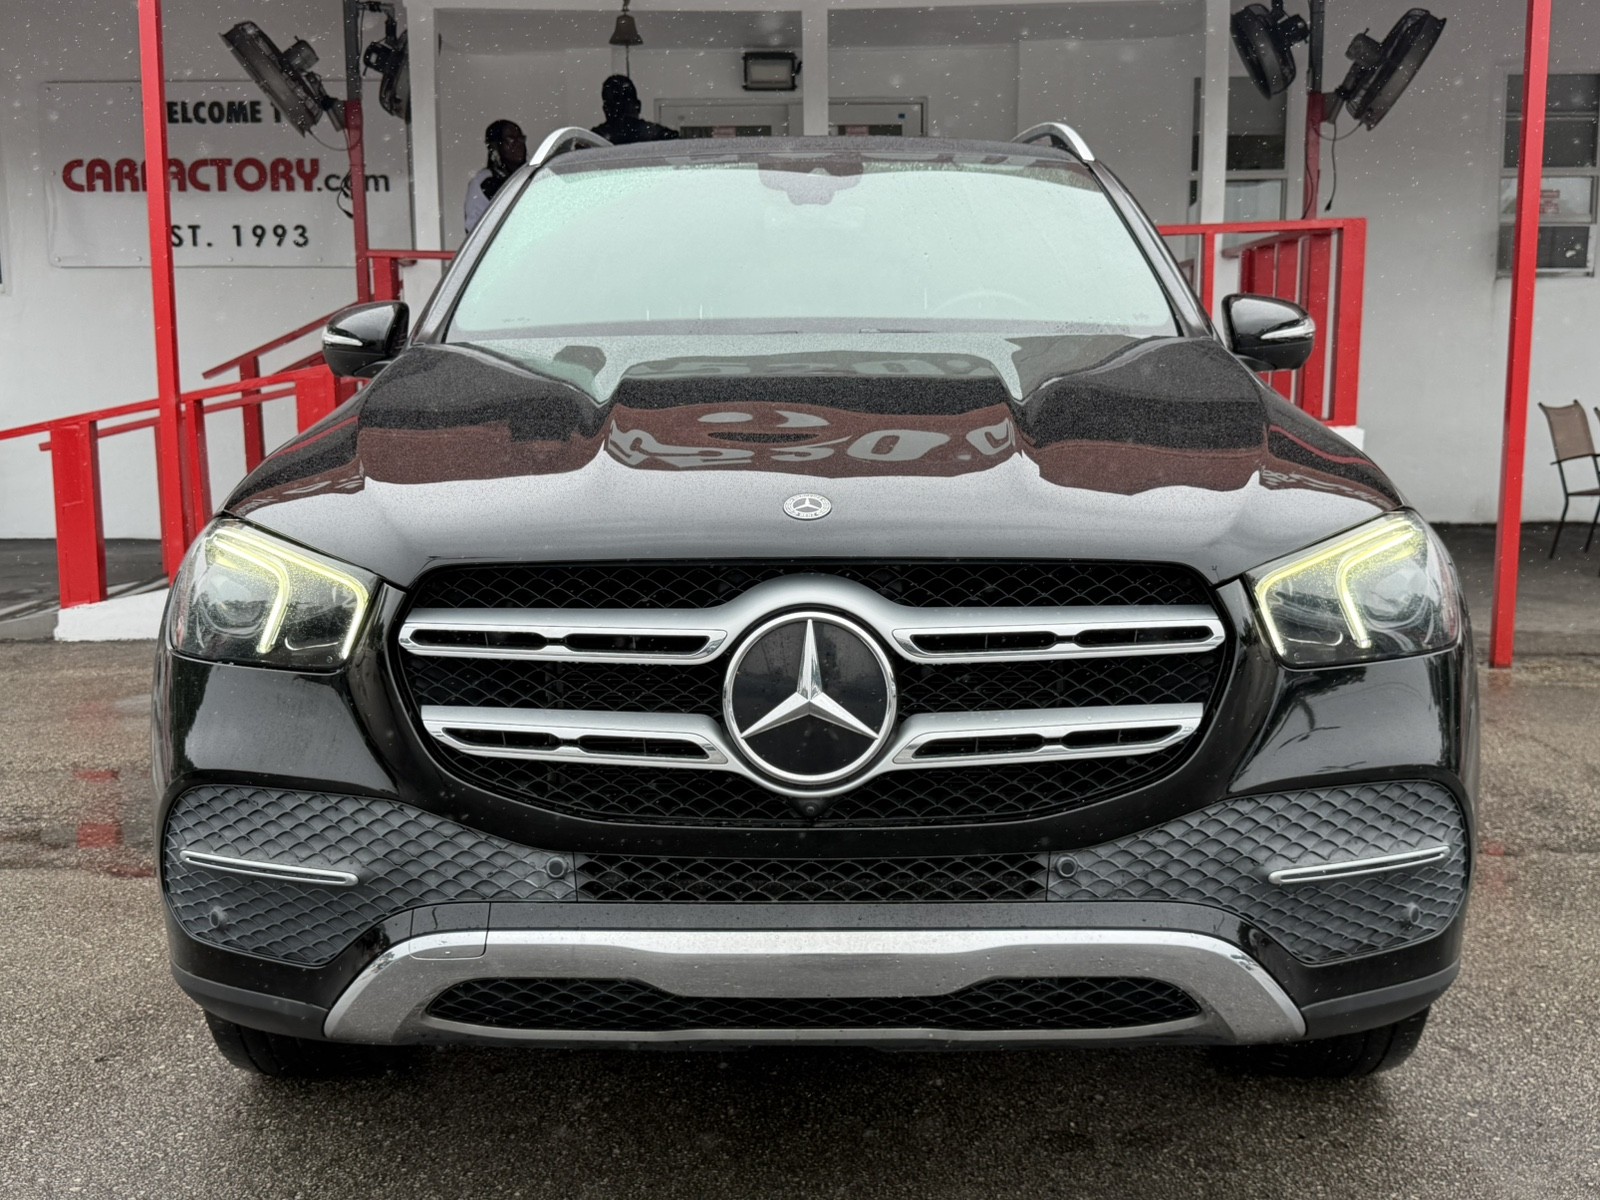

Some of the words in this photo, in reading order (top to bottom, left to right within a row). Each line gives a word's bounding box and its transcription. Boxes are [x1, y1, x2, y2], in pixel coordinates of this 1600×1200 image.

[142, 100, 263, 124] ELCOME
[62, 157, 390, 193] CARACTORY.cm
[170, 224, 214, 248] ST.
[231, 224, 310, 248] 1993
